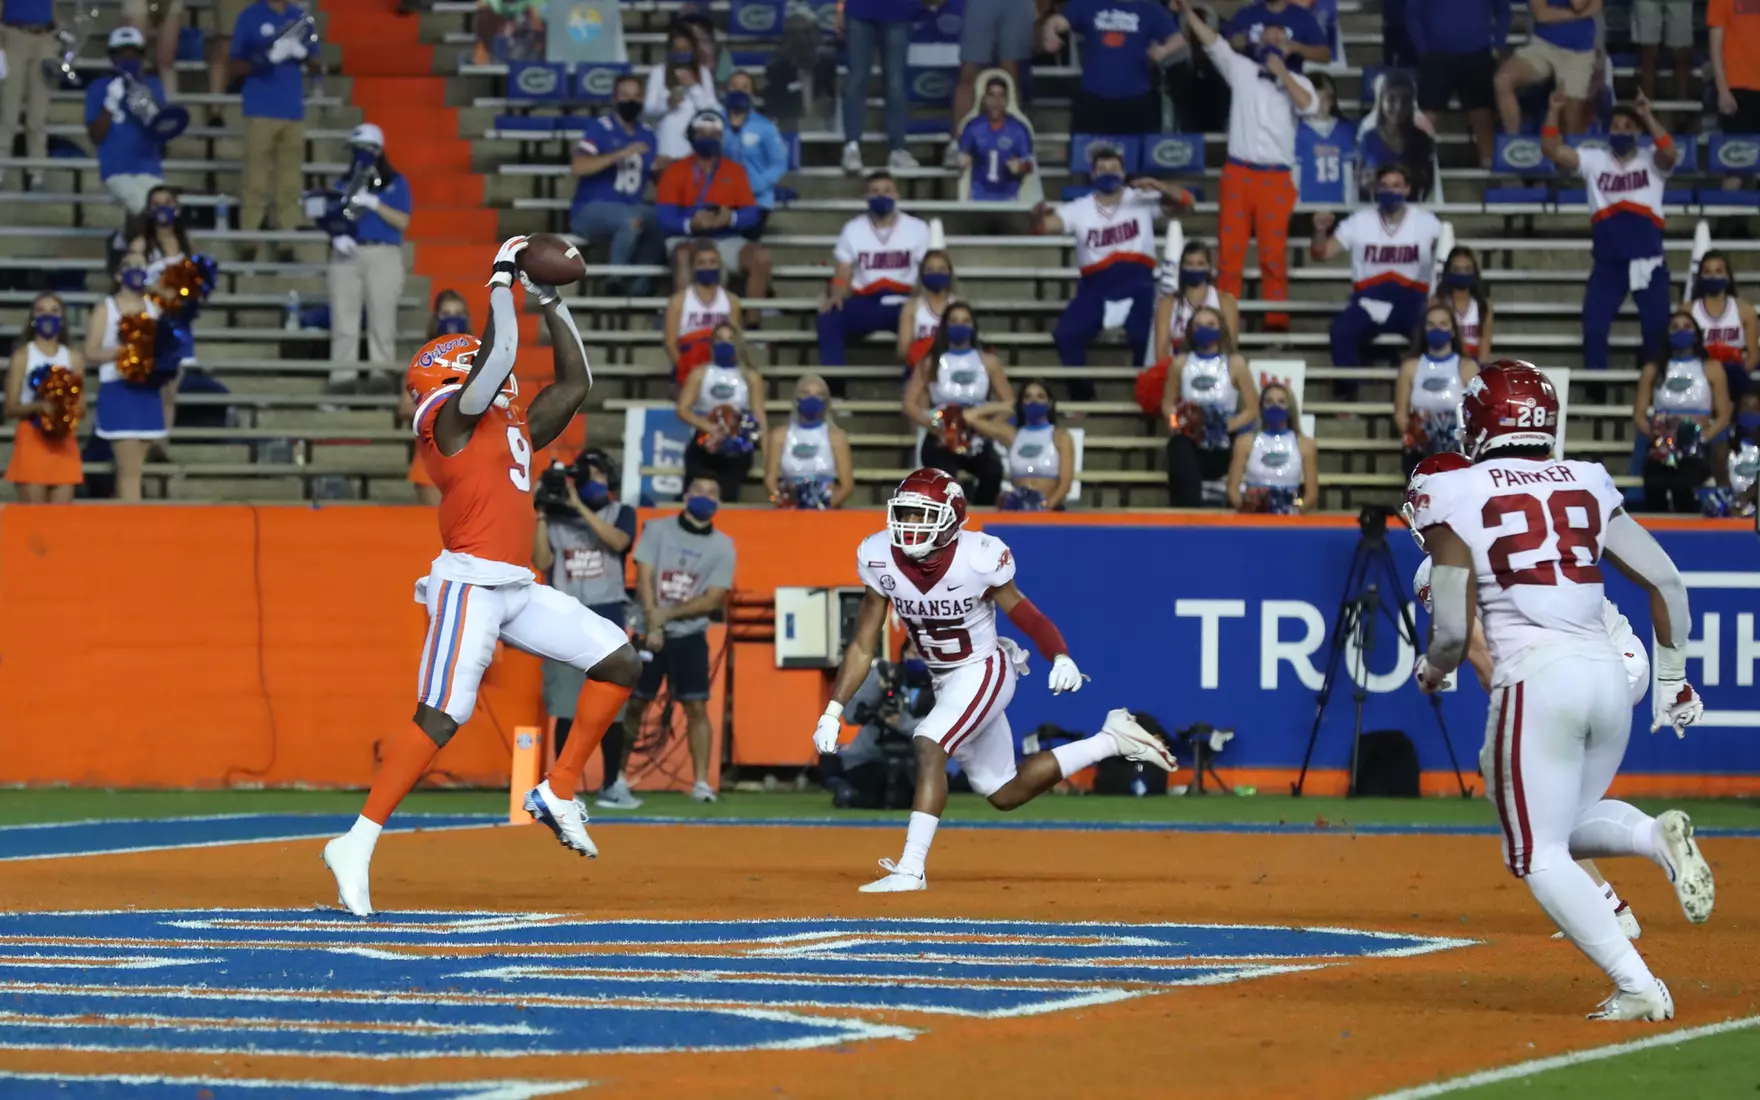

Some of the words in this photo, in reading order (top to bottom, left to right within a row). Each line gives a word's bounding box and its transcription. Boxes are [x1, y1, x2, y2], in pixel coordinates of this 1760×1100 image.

[986, 150, 999, 182] 1
[1315, 156, 1340, 182] 15
[1598, 169, 1650, 192] FLORIDA
[1086, 218, 1139, 249] FLORIDA
[858, 251, 910, 270] FLORIDA
[1364, 244, 1419, 264] FLORIDA
[420, 337, 469, 367] Gators
[1517, 406, 1546, 427] 28
[507, 424, 532, 492] 9
[1488, 465, 1576, 487] PARKER
[1482, 489, 1603, 590] 28
[902, 617, 973, 662] 15
